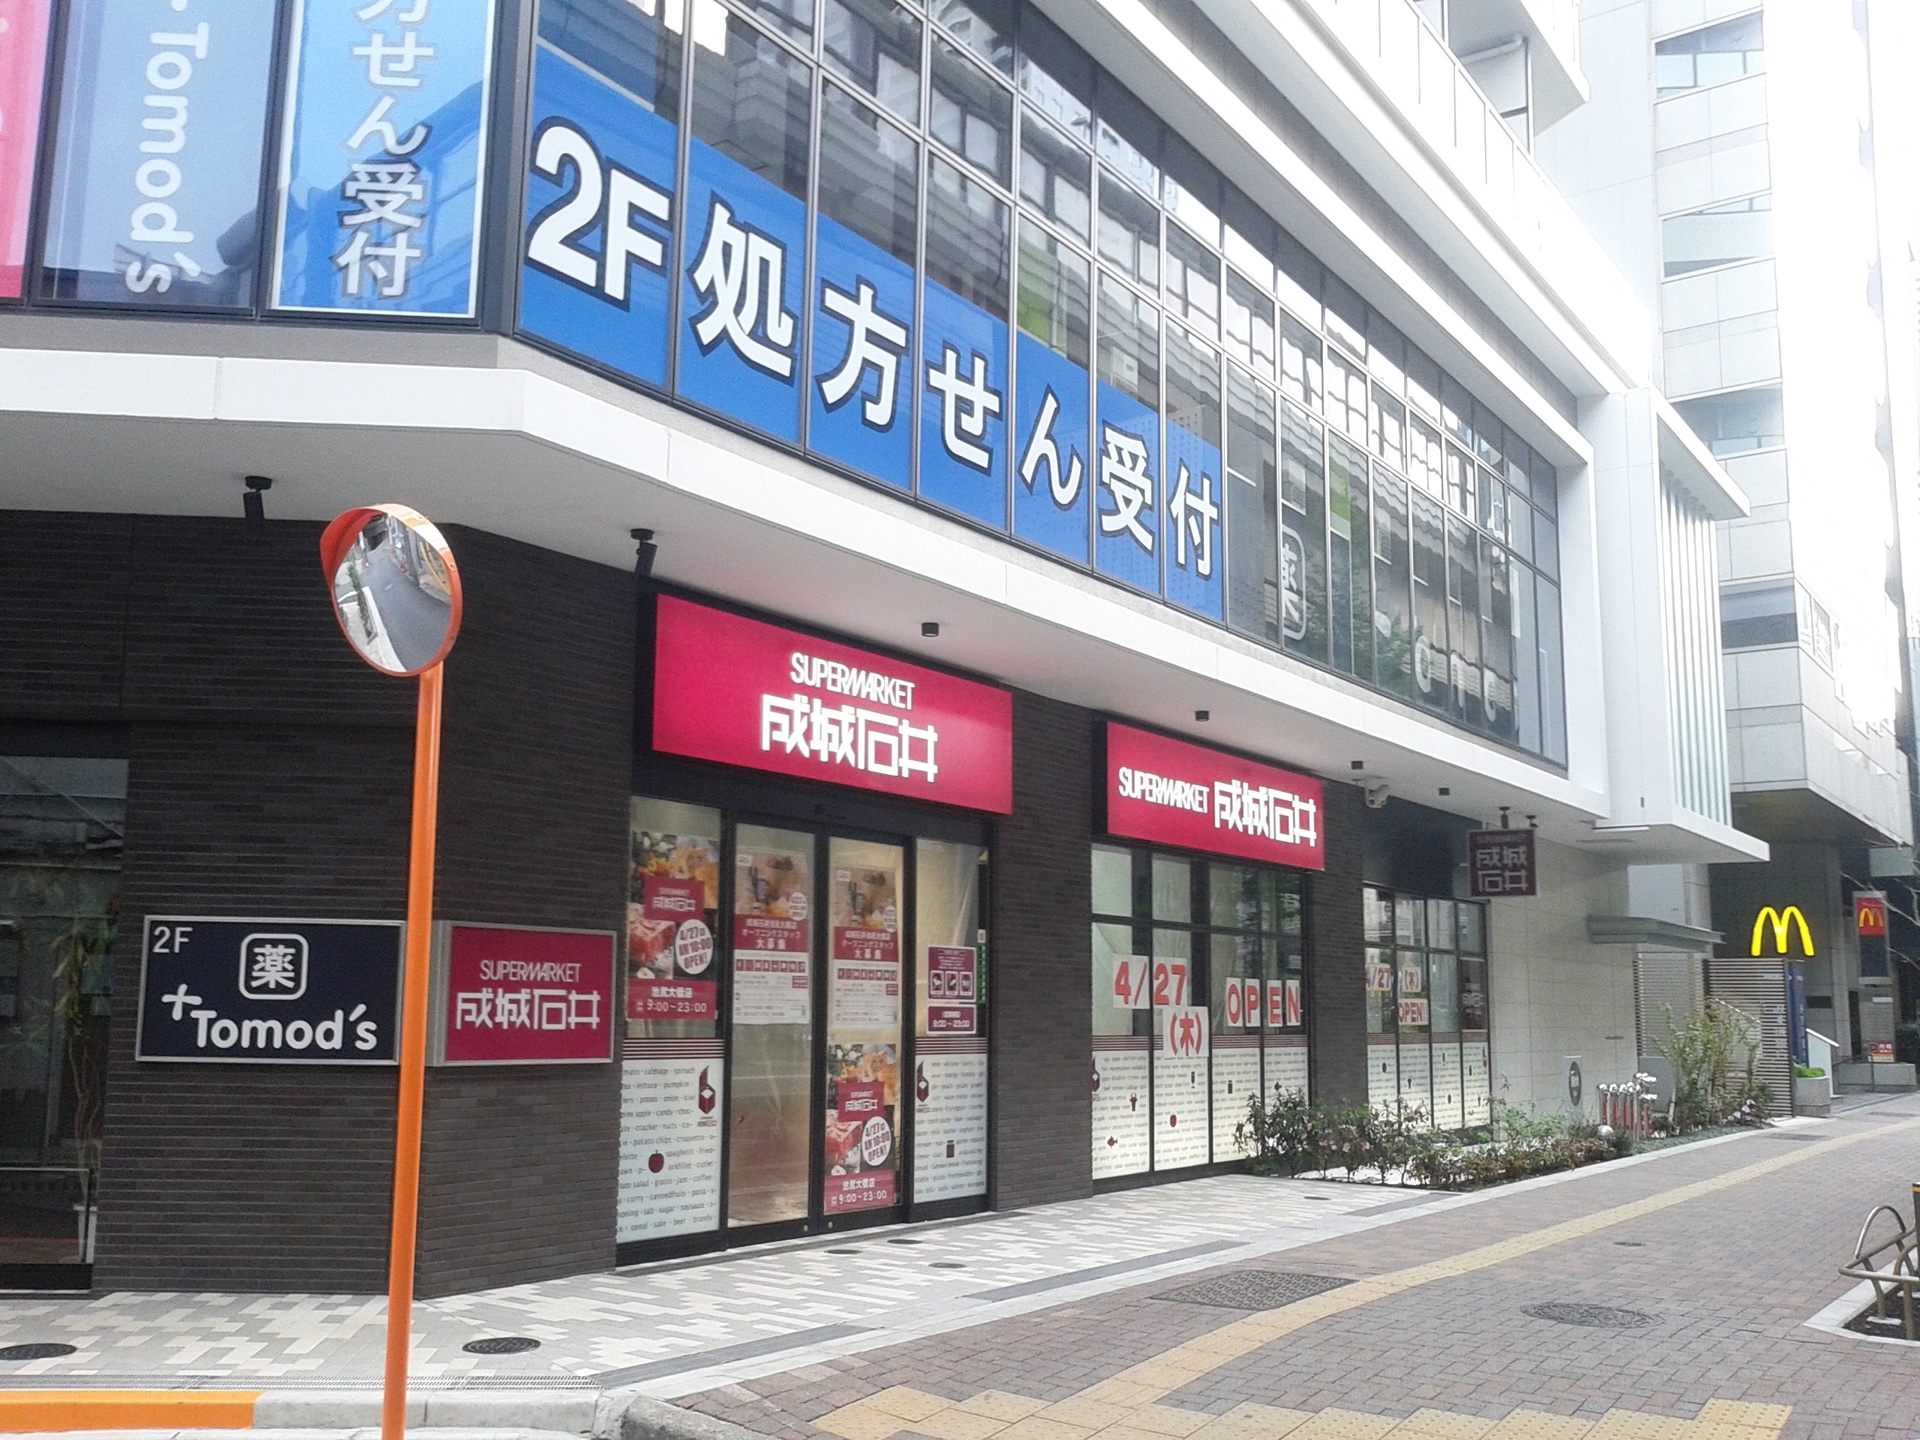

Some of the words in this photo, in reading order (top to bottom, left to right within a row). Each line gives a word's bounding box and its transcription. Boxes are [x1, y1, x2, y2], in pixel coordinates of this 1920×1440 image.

[125, 22, 209, 294] Tomod's
[525, 117, 672, 310] 2F
[689, 190, 1220, 578] 処方せん受付
[790, 651, 915, 711] SUPERMARKET
[759, 692, 939, 783] 成城石井
[1118, 766, 1209, 814] SUPERMARKET
[1213, 778, 1318, 847] 成城石井
[152, 926, 194, 954] 2F
[253, 944, 295, 989] 薬
[479, 959, 582, 984] SUPERMARKET
[1114, 961, 1186, 1006] 4/27
[455, 987, 600, 1031] 成城石井
[1227, 983, 1300, 1024] OPEN
